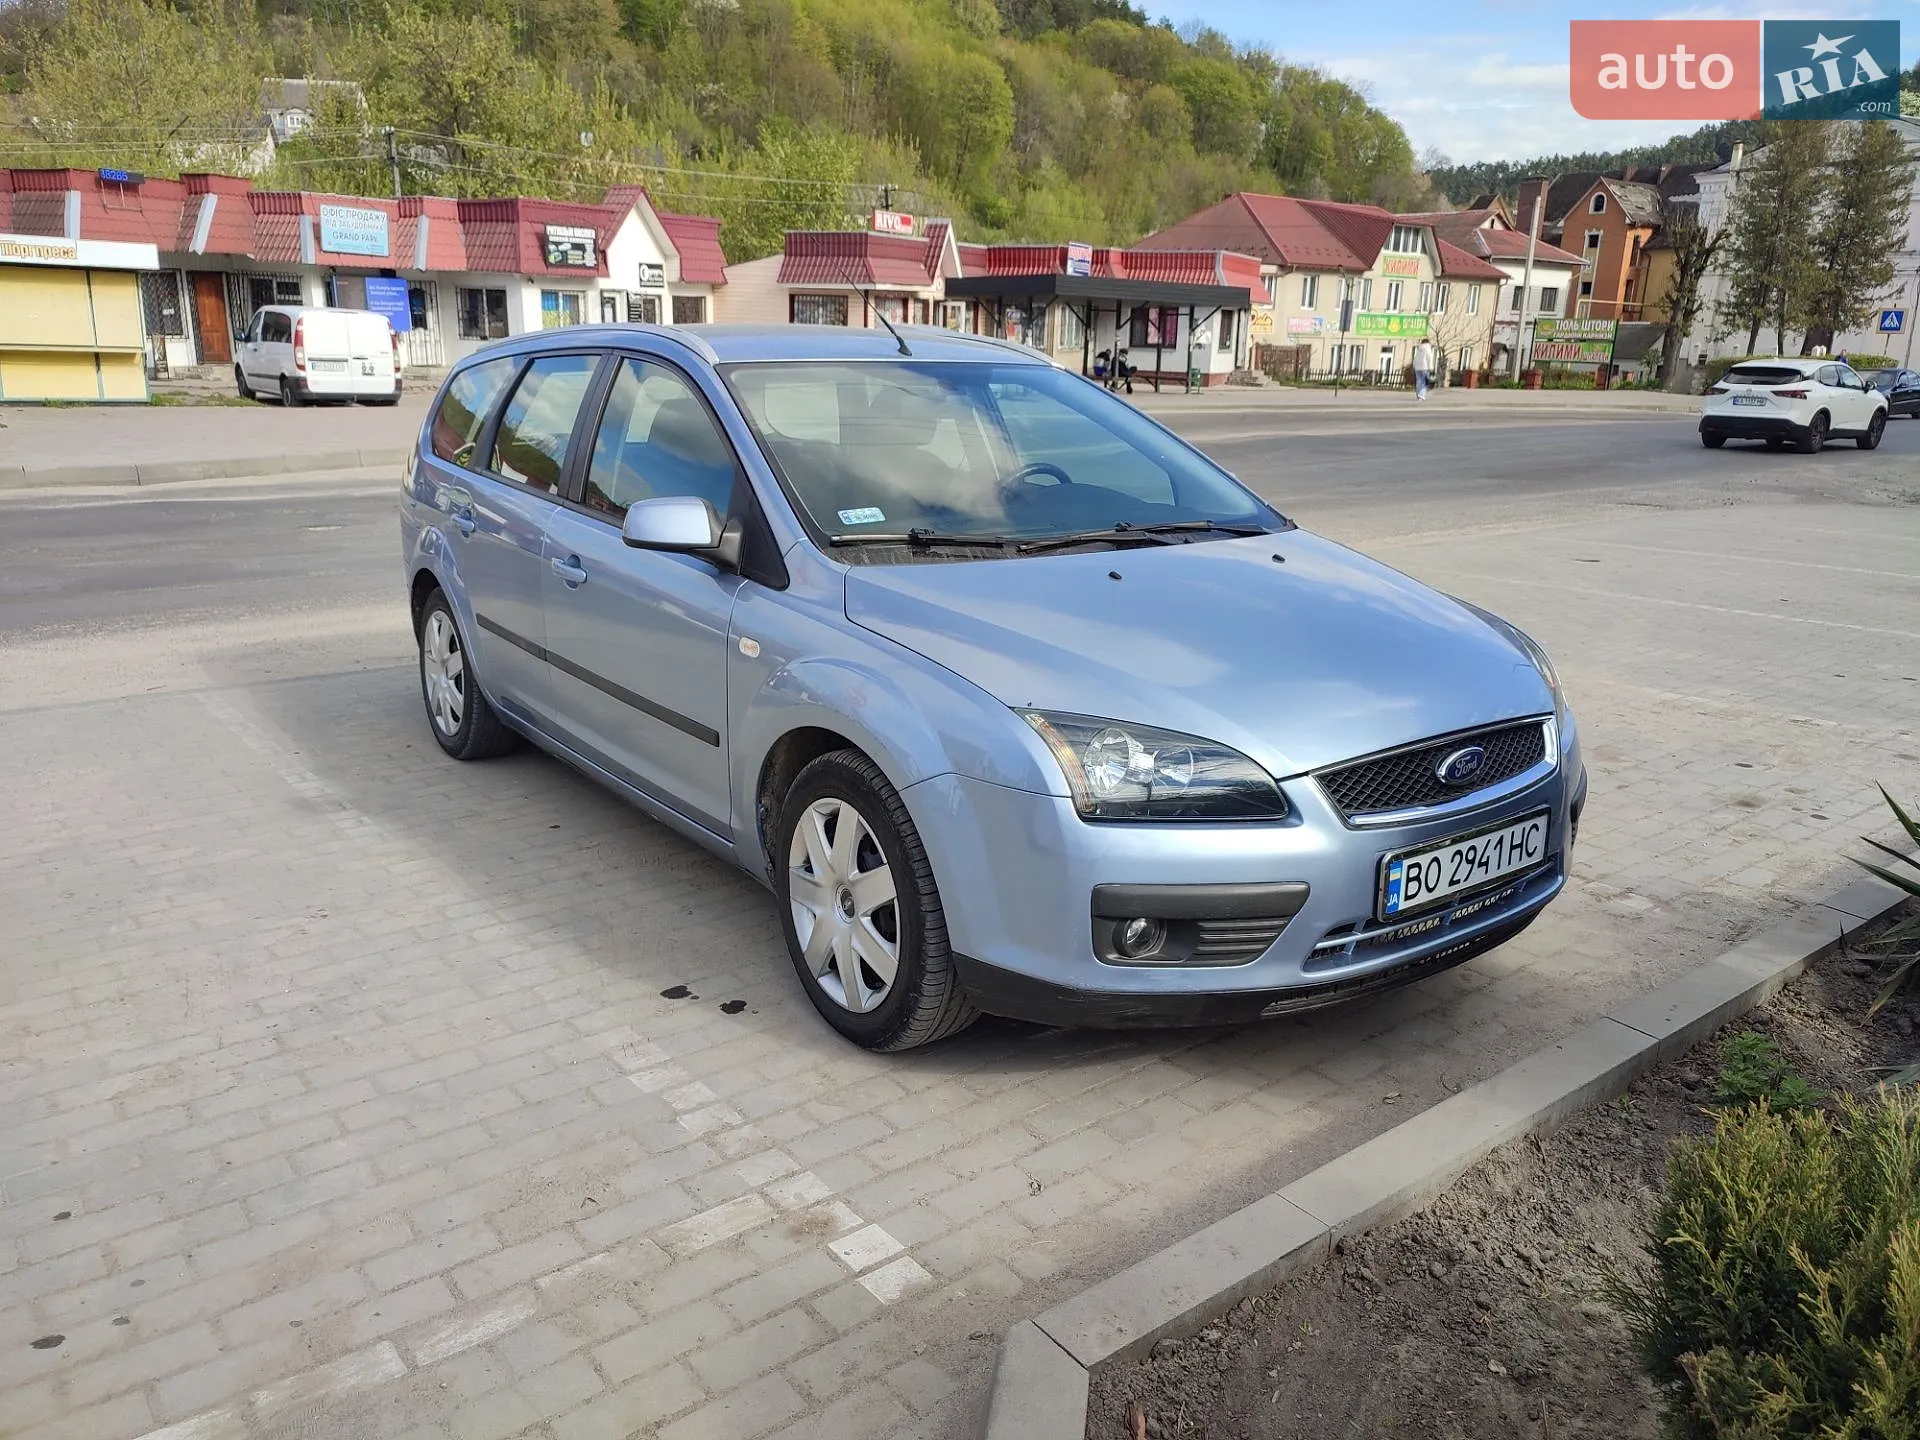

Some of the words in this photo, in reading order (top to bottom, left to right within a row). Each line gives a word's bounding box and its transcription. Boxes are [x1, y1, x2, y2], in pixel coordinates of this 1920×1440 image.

[323, 207, 344, 217] ОФІС
[346, 209, 386, 222] ПРОДАЖУ
[332, 231, 359, 241] GRAND
[1556, 320, 1580, 330] ТЮЛЬ
[1581, 320, 1613, 332] ШТОРИ
[1454, 755, 1477, 776] Ford
[1404, 856, 1442, 902] BO
[1448, 835, 1504, 888] 2941
[1507, 823, 1540, 867] HC
